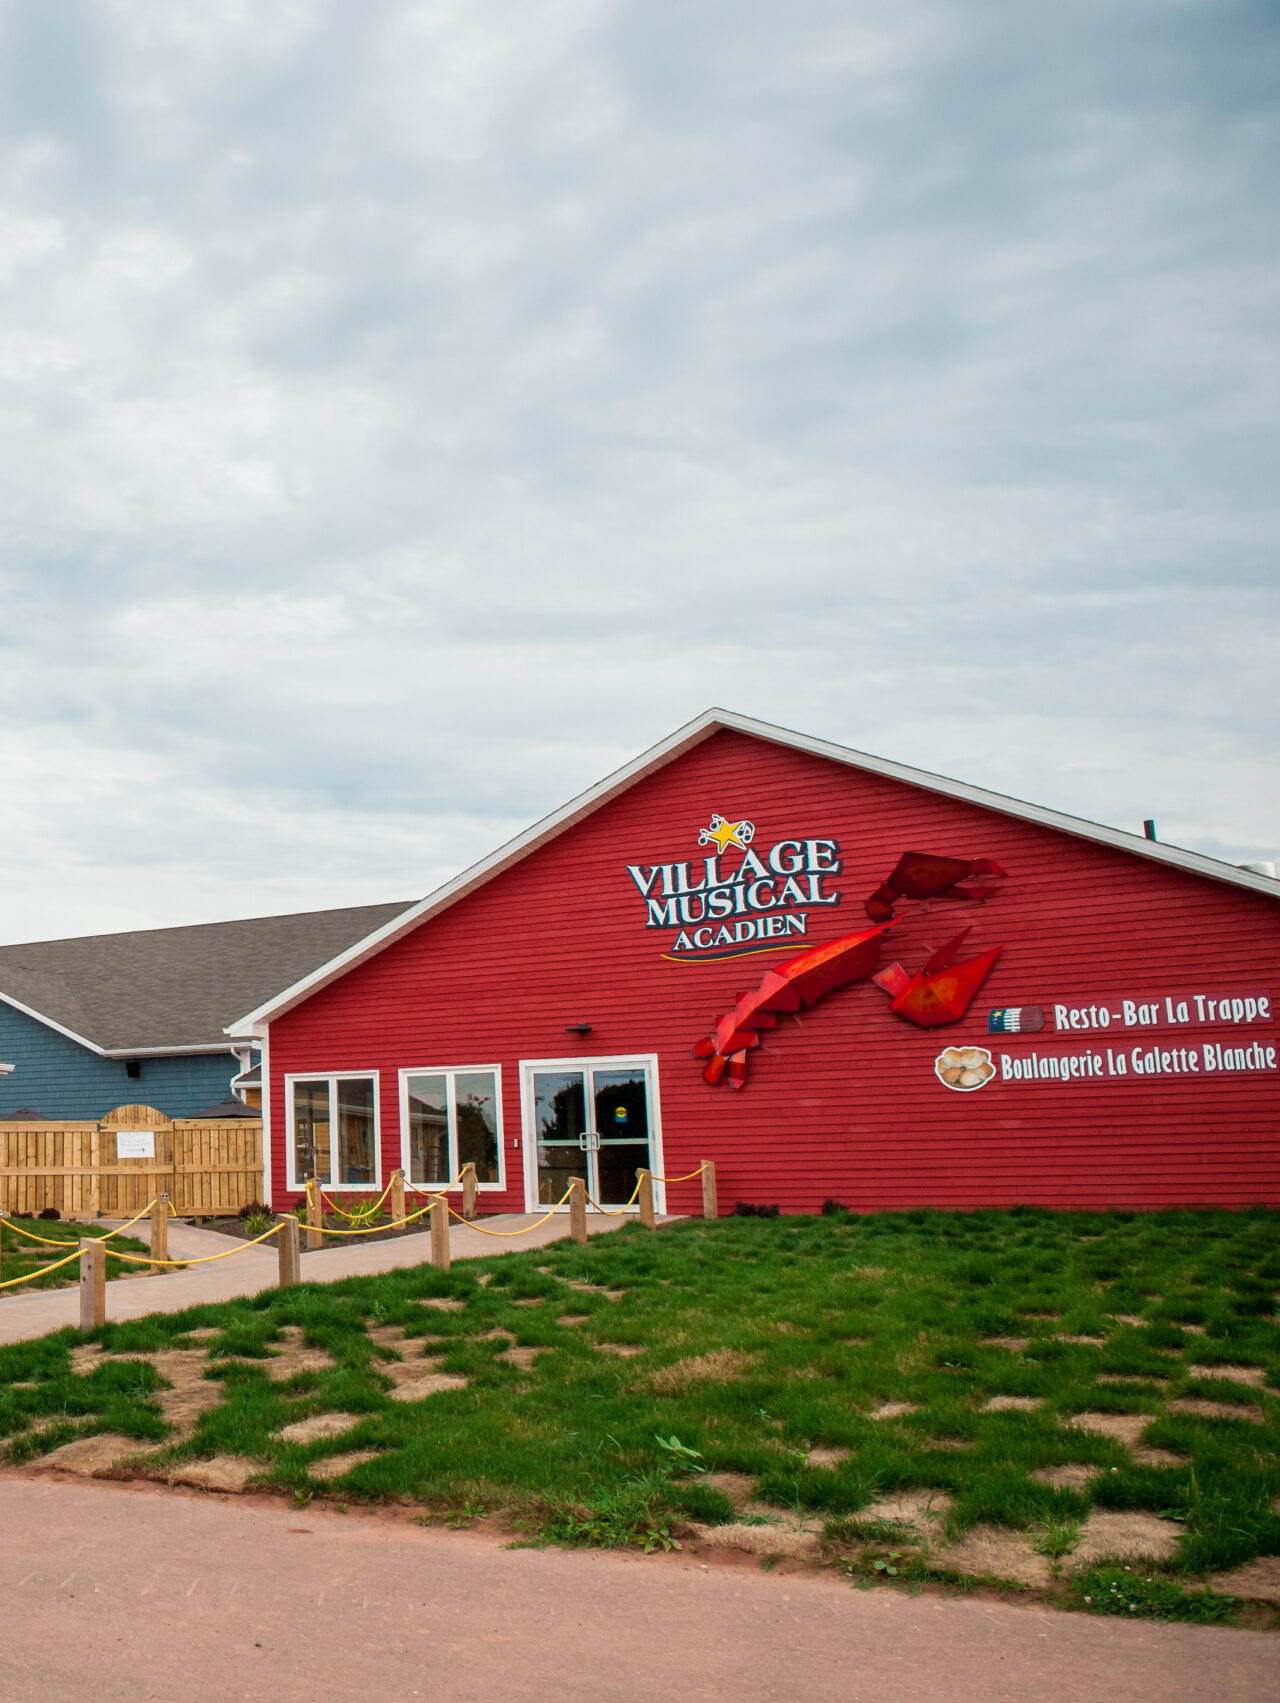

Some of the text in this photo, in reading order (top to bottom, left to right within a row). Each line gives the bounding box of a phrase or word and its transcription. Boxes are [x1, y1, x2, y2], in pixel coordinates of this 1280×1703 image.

[626, 840, 840, 896] VILLAGE
[645, 874, 838, 926] MUSICAL
[672, 913, 808, 951] ACADIEN
[1054, 995, 1271, 1030] Resto-Bar La Trappe
[1000, 1042, 1277, 1081] Boulangerie La Galette Blanche
